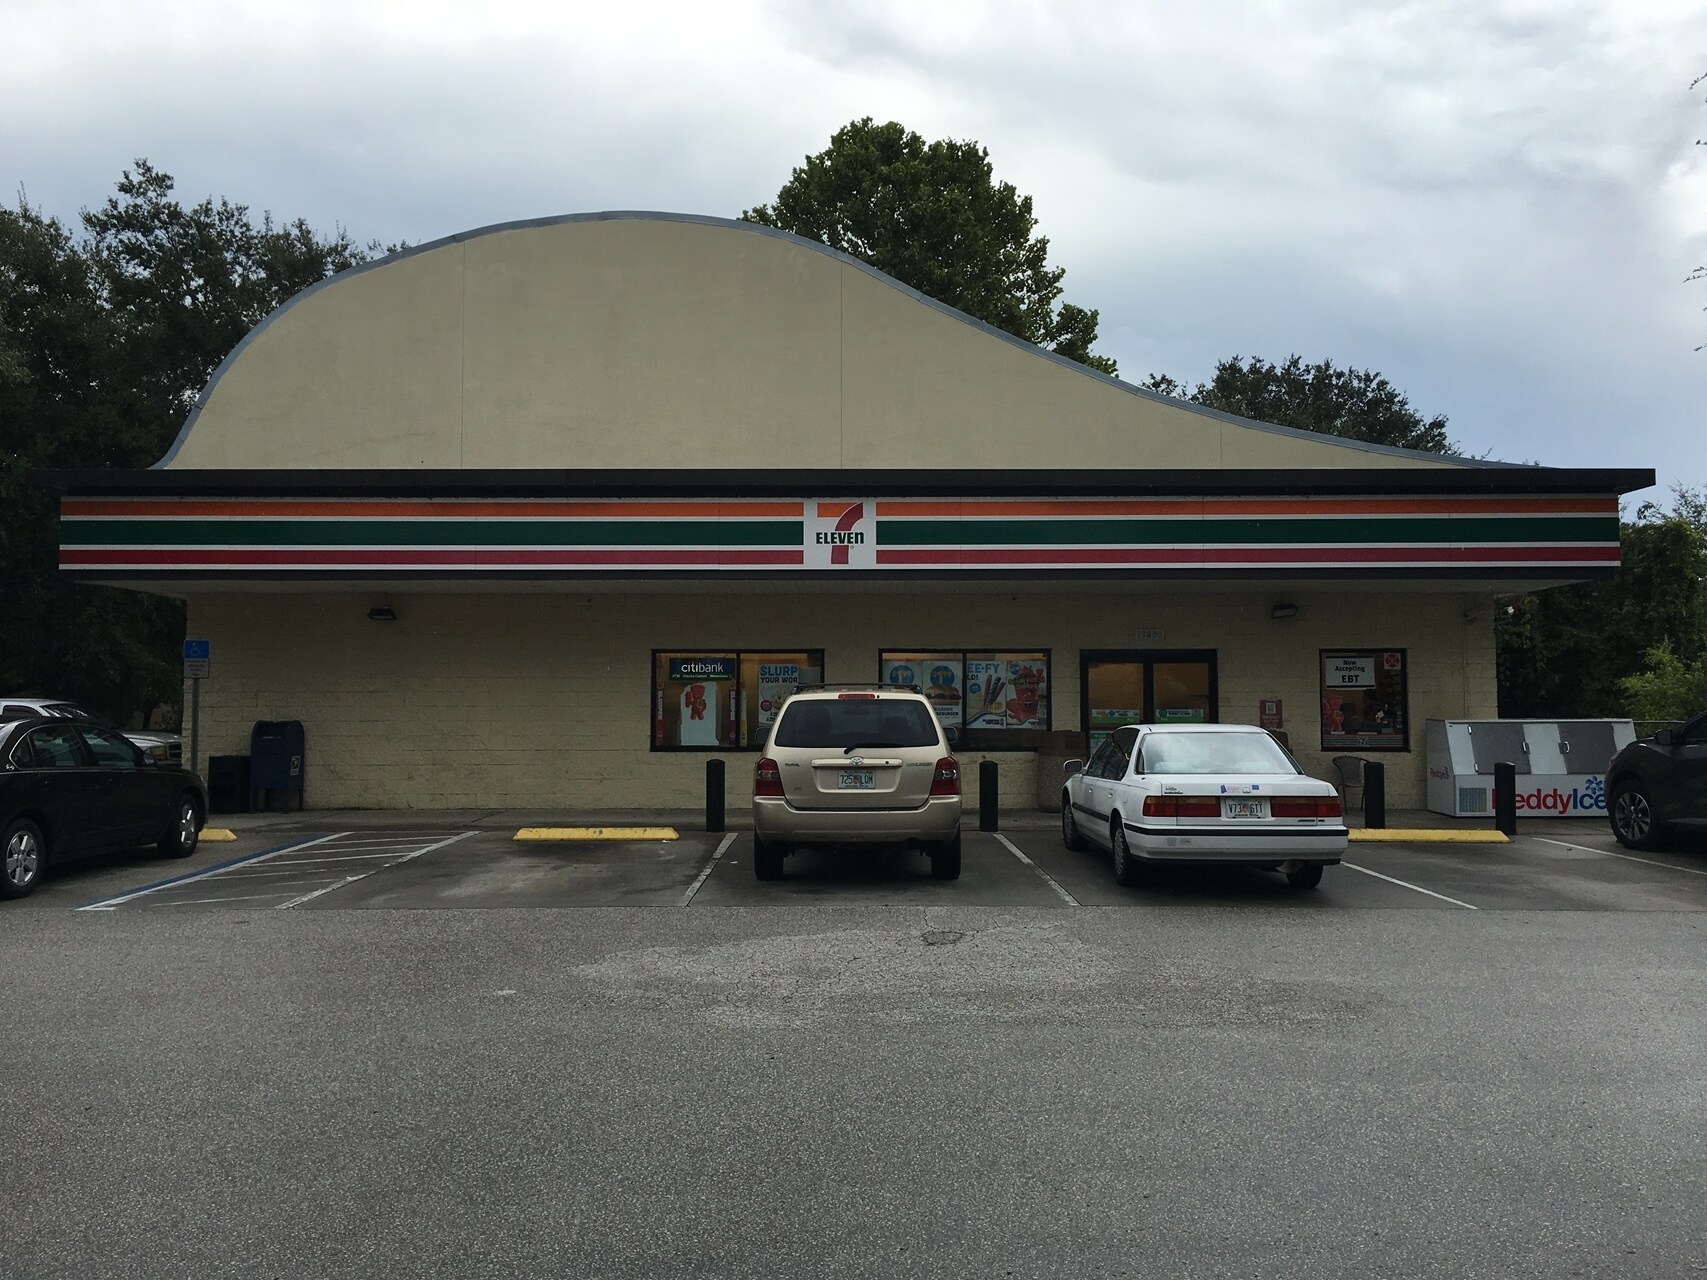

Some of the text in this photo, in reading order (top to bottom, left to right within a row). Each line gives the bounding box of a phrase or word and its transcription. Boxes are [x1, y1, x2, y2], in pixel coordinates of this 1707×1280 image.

[817, 502, 863, 565] 7
[681, 662, 724, 673] citibank
[760, 666, 798, 676] SLURP
[1341, 675, 1360, 683] EBT
[840, 774, 853, 784] 725
[1491, 788, 1607, 814] eddyIce
